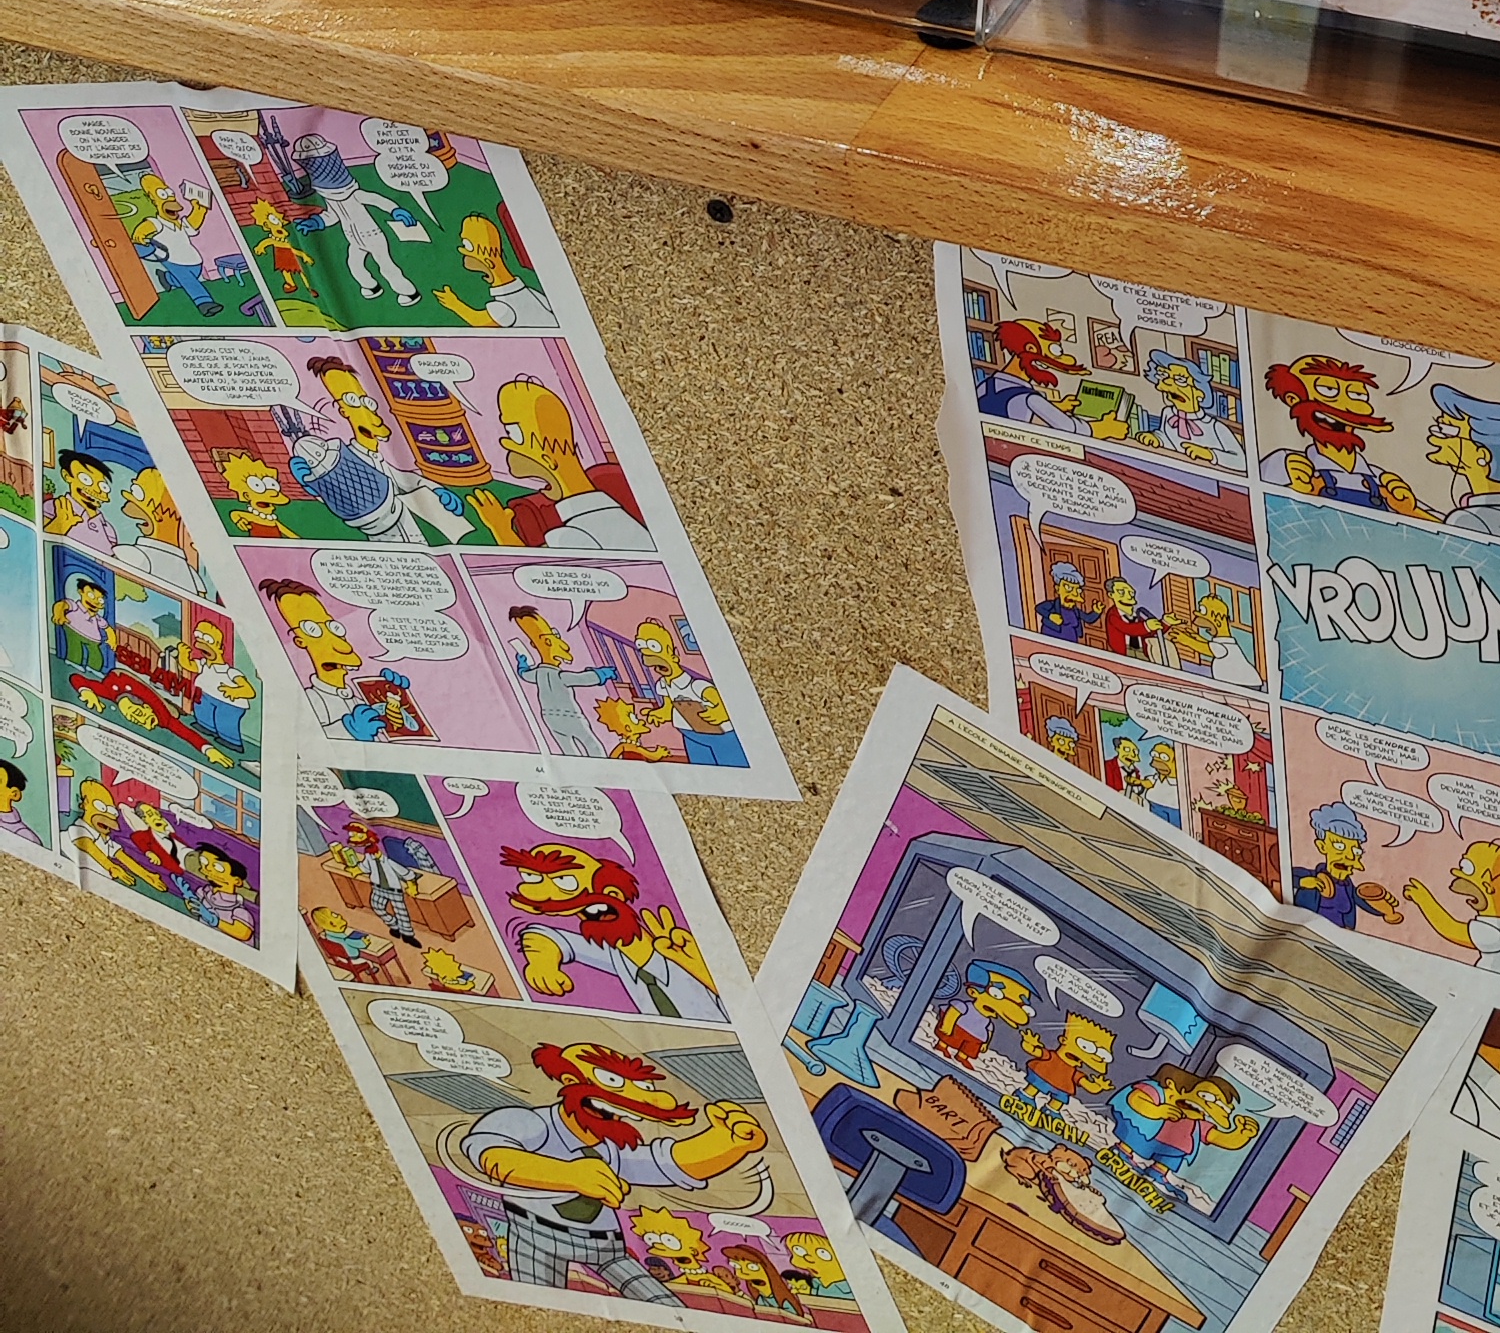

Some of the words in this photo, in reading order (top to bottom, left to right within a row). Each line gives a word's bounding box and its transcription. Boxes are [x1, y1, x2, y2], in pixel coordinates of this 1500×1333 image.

[1131, 688, 1193, 710] L'ASPIRATEUR
[1195, 705, 1246, 723] HOMERLUX
[1136, 697, 1158, 711] VOUS
[1156, 703, 1201, 721] GARANTIT
[1204, 716, 1225, 727] QU'IL
[1228, 721, 1240, 731] NE
[1324, 731, 1337, 741] DE
[1339, 735, 1360, 746] MON
[1362, 741, 1395, 756] DÉFUNT
[1398, 751, 1420, 762] MARI
[1354, 732, 1369, 742] LES
[1372, 736, 1416, 754] CENDRES
[924, 1095, 968, 1128] BART
[999, 1093, 1090, 1147] CRUNCH!
[1096, 1148, 1175, 1215] CRUNCH!
